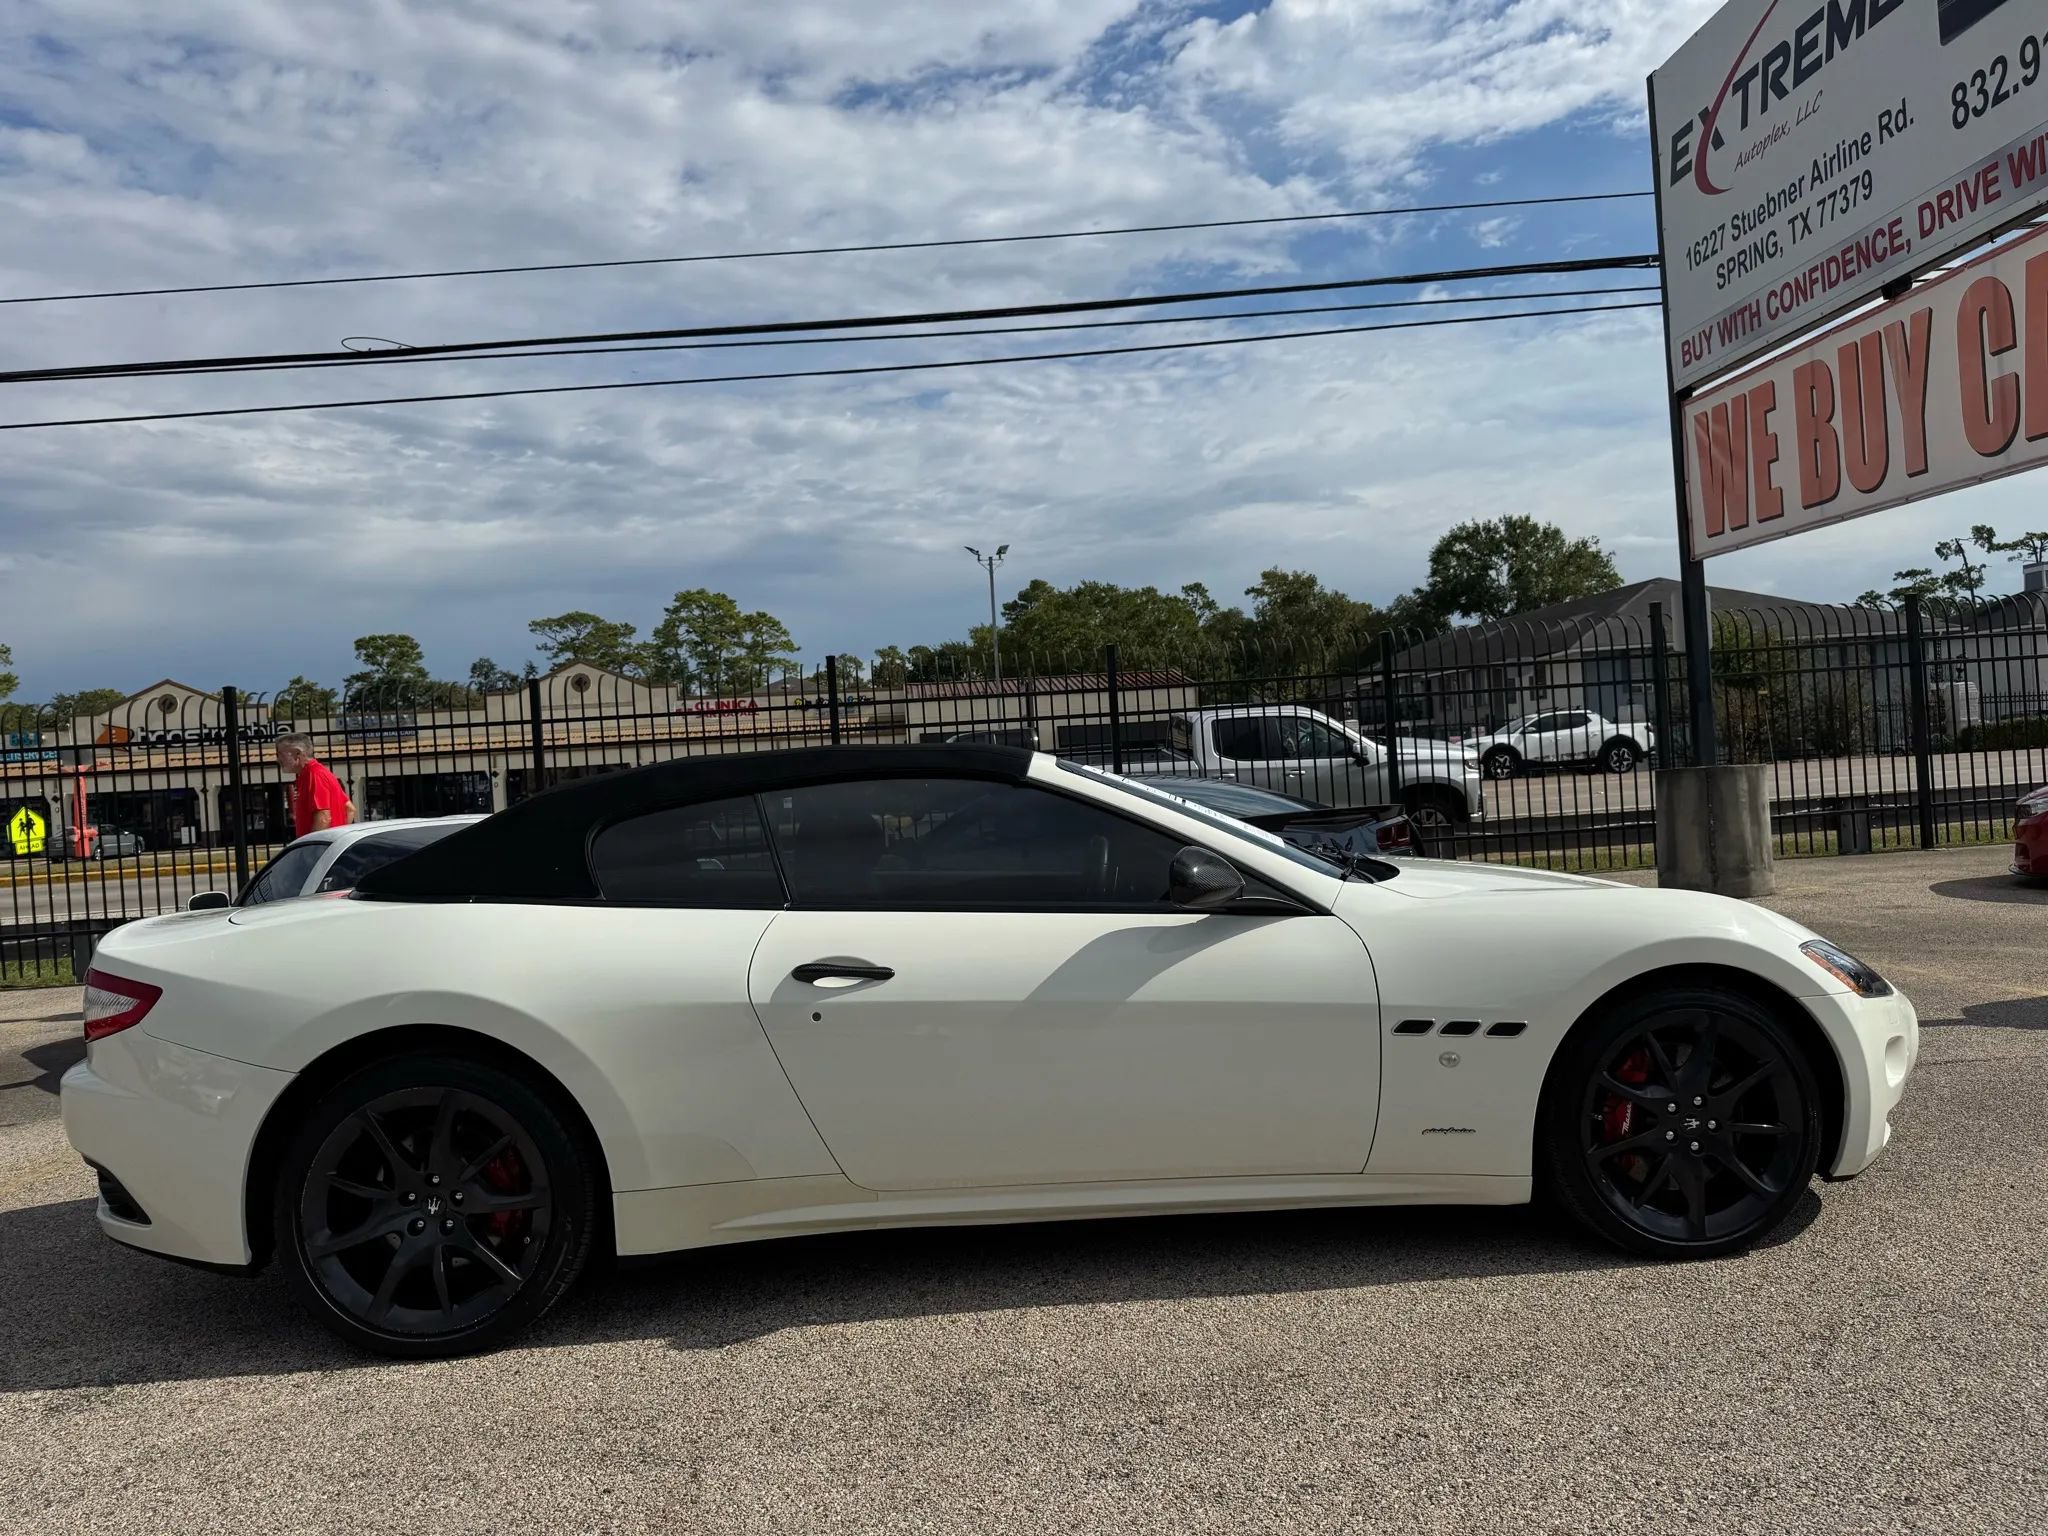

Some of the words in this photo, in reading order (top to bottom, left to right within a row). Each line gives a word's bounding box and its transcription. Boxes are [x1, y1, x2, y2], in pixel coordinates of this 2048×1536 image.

[1685, 222, 1726, 272] 16227
[1731, 174, 1805, 242] Stuebner
[1810, 131, 1872, 191] Airline
[1877, 97, 1914, 146] Rd.
[1734, 121, 1791, 173] Autoplex,
[1795, 89, 1824, 127] LLC
[1681, 325, 1713, 369] BUY
[1717, 298, 1762, 348] WITH
[1766, 217, 1912, 321] CONFIDENCE,
[1917, 160, 2002, 240] DRIVE
[1716, 230, 1784, 290] SPRING,
[1787, 206, 1813, 245] TX
[1816, 168, 1873, 228] 77379
[1693, 380, 1785, 538] WE
[1793, 306, 1933, 511] BUY
